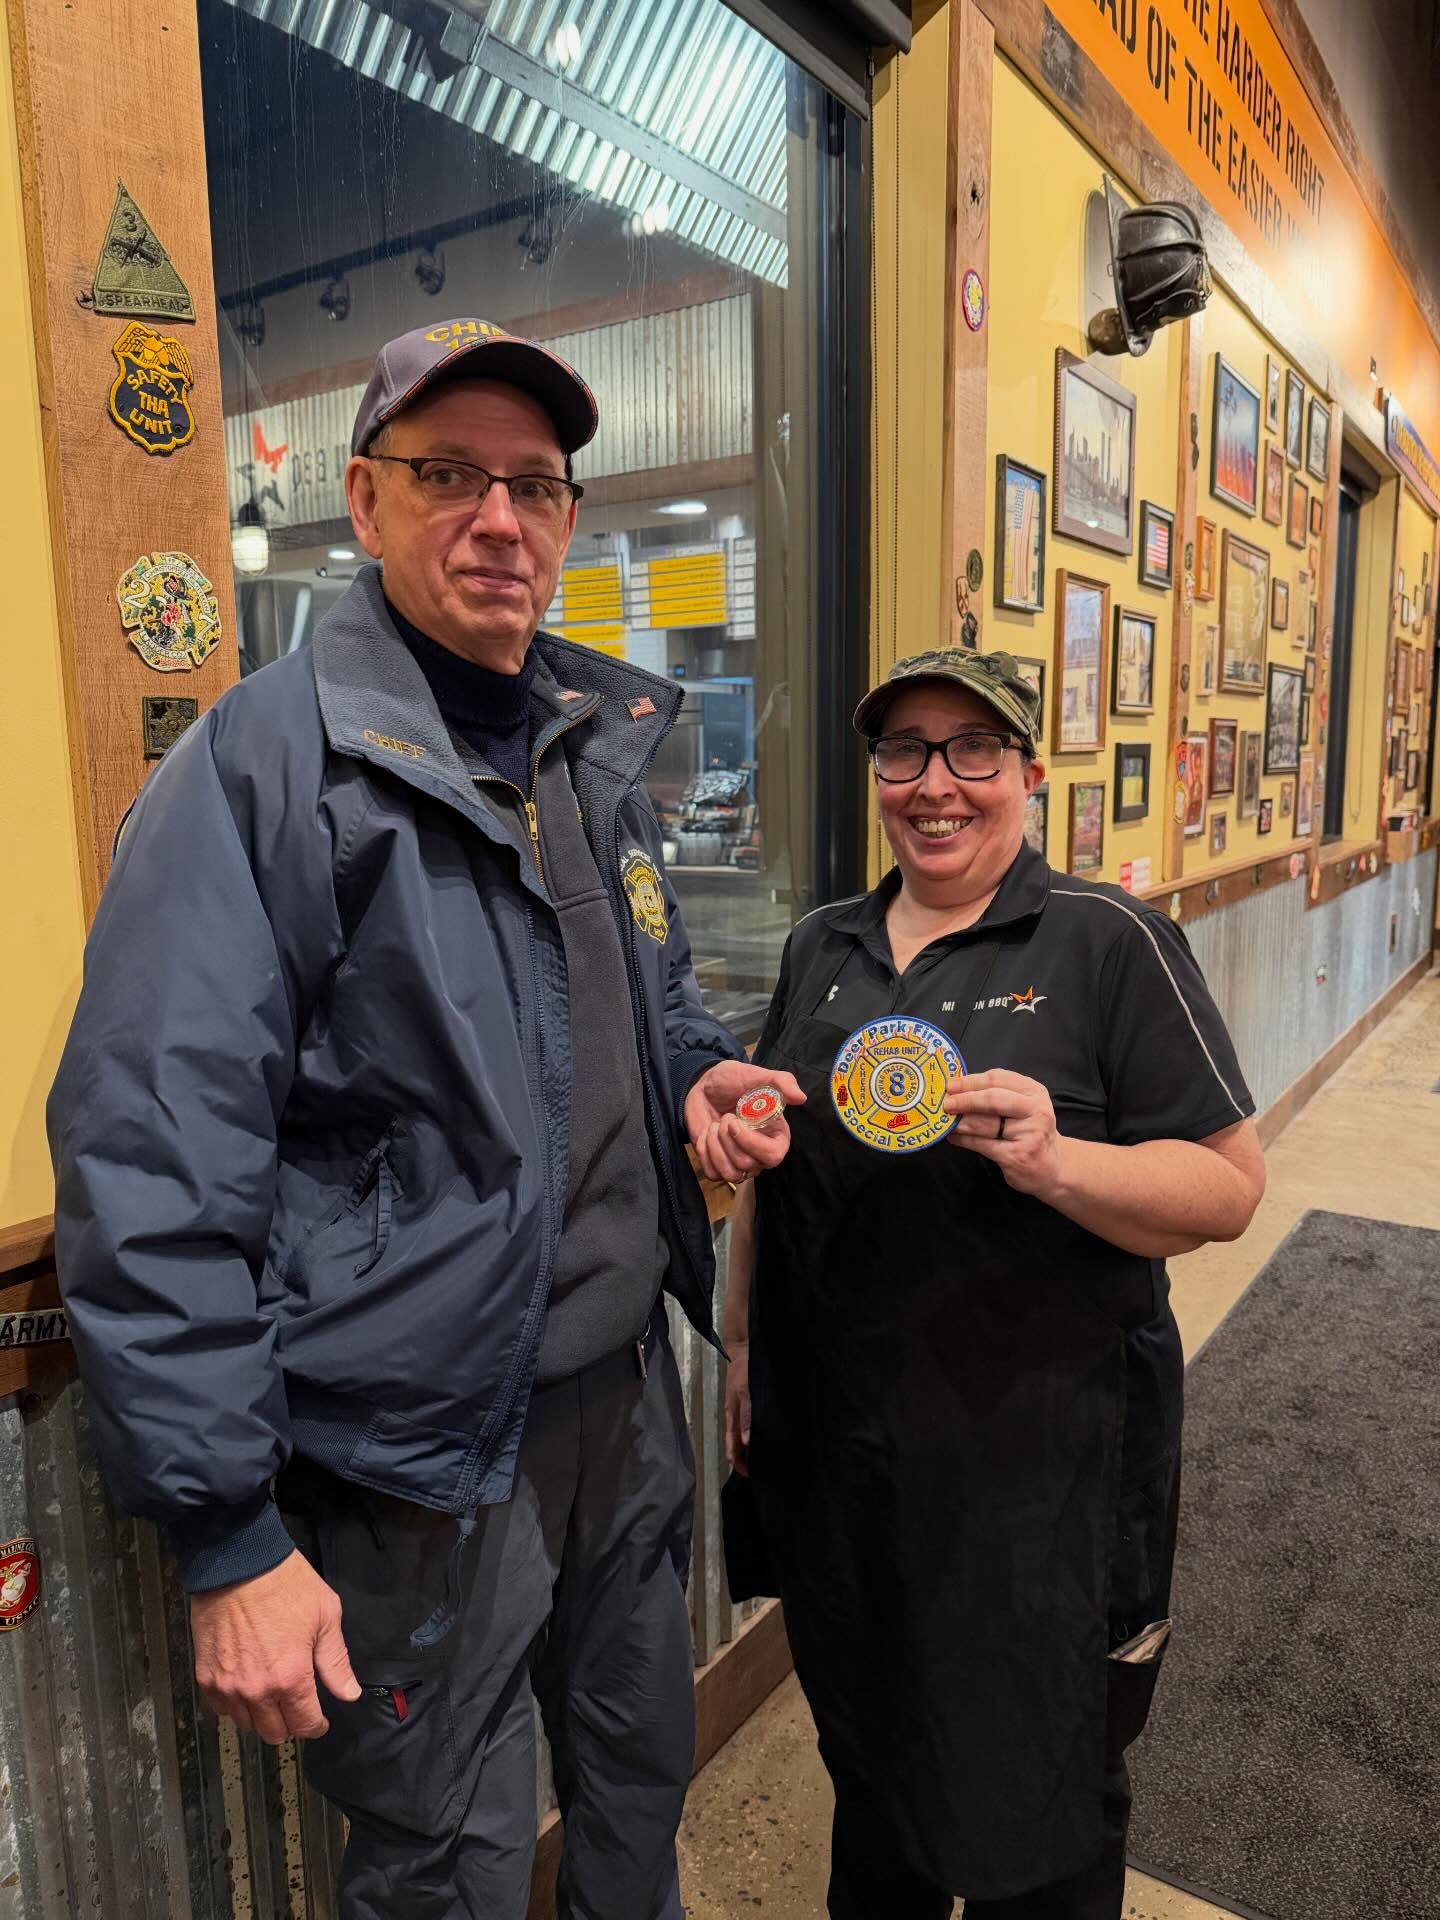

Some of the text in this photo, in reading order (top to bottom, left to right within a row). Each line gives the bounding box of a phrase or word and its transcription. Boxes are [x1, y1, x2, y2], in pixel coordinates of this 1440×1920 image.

[1147, 5, 1177, 104] OF
[1184, 56, 1223, 173] THE
[1227, 122, 1282, 250] EASIER
[1216, 0, 1325, 226] HARDER RIGHT
[123, 211, 138, 232] 3
[104, 294, 185, 312] SPEARHEAD
[126, 369, 183, 405] SAFETY
[138, 391, 170, 420] THA
[129, 407, 173, 436] UNIT
[987, 996, 1008, 1008] BBQ
[837, 1037, 866, 1074] Deer
[867, 1021, 908, 1040] Park
[912, 1023, 943, 1048] Fire
[873, 1046, 921, 1057] REHAB UNIT
[889, 1071, 906, 1097] 8
[929, 1062, 937, 1107] HILL
[843, 1107, 950, 1148] Special Service
[0, 1313, 68, 1343] ARMY
